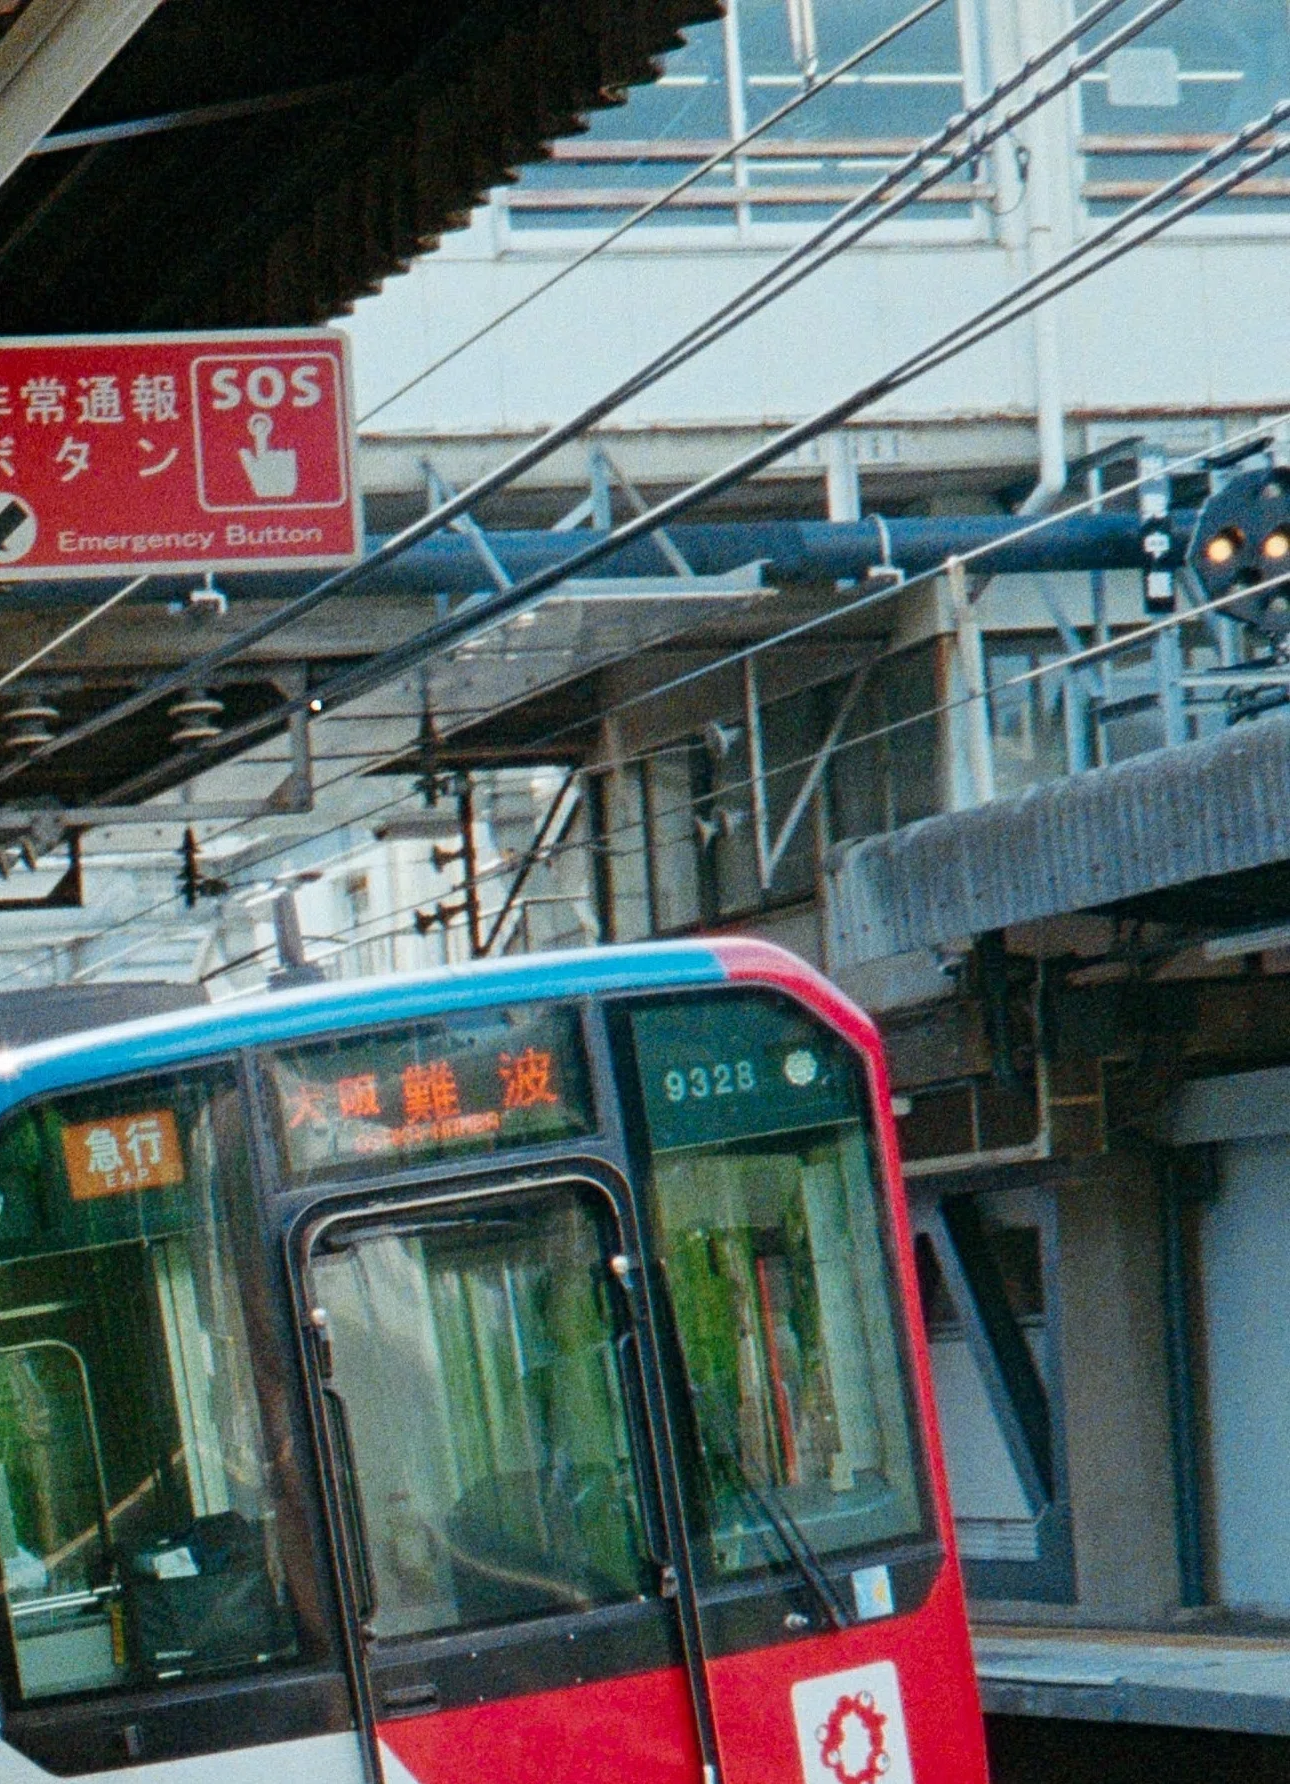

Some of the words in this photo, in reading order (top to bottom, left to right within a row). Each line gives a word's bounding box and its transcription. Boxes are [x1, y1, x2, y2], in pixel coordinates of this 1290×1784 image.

[211, 364, 322, 410] SOS
[57, 527, 214, 553] Emergency
[225, 523, 323, 547] Button
[664, 1060, 755, 1102] 9328
[84, 1118, 163, 1173] 急行
